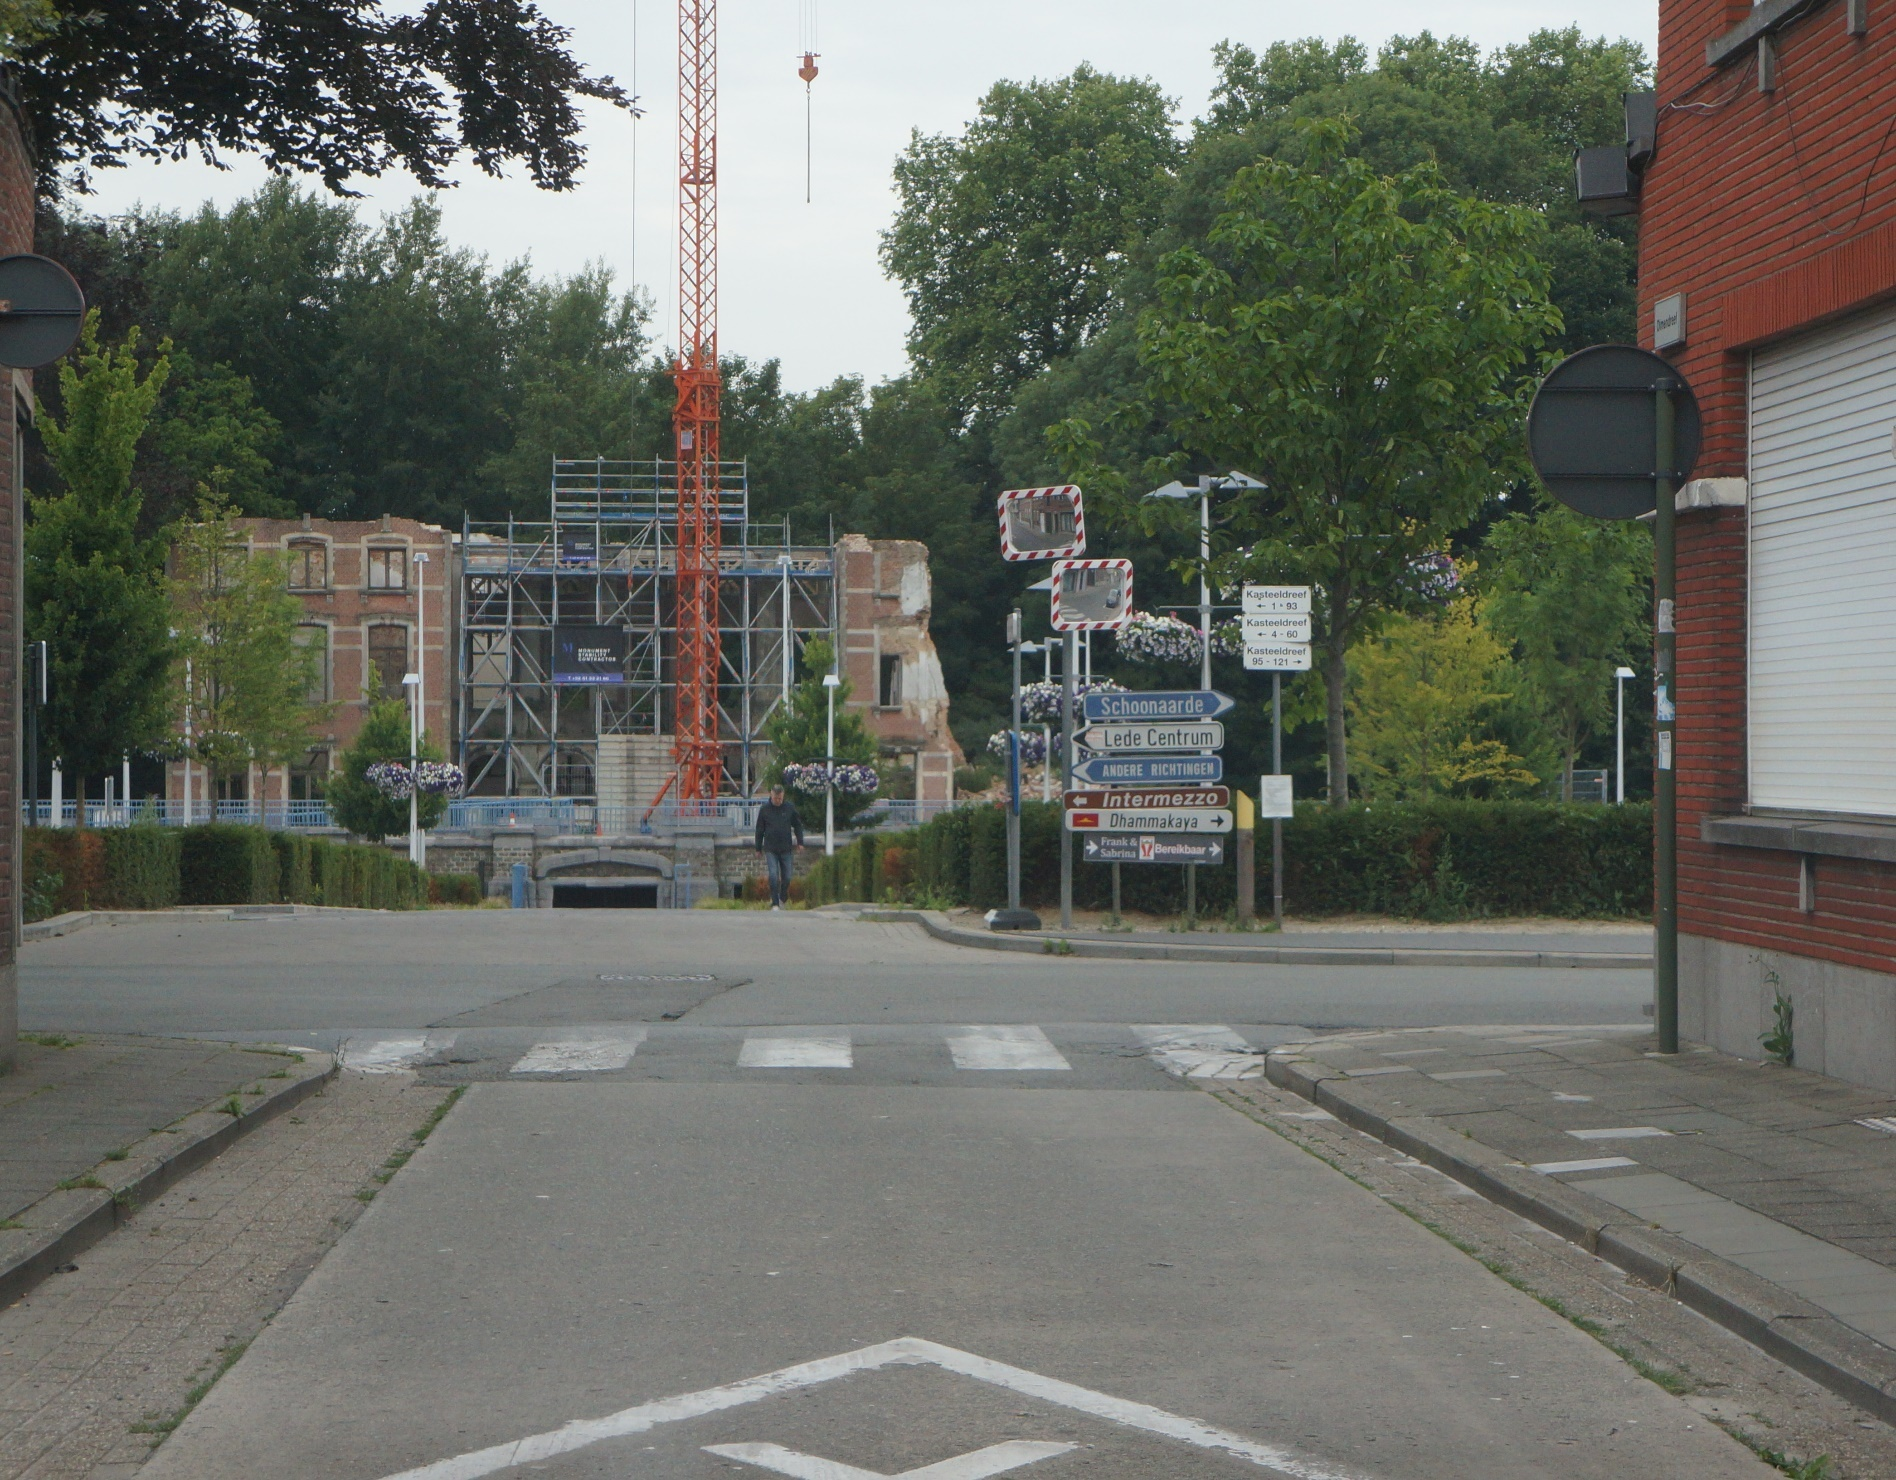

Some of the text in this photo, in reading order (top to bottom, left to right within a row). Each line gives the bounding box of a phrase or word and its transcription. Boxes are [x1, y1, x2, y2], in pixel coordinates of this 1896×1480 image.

[1246, 590, 1307, 598] Kasteeldreef
[1271, 602, 1276, 610] 1
[1286, 602, 1298, 610] 93
[1246, 619, 1308, 627] Kasteeldreef
[1271, 630, 1277, 638] 4
[1286, 630, 1298, 638] 60
[1246, 647, 1307, 655] Kasteeldreef
[1252, 657, 1263, 665] 95
[1273, 658, 1289, 666] 121
[1101, 695, 1204, 715] Schoonaarde
[1104, 728, 1213, 747] Lede Centrum
[1102, 762, 1214, 777] ANDERE RICHTINGEN
[1102, 791, 1218, 808] Intermezzo
[1110, 813, 1198, 831] Dhammakaya
[1100, 837, 1138, 846] Frank &
[1100, 849, 1136, 858] Sabrina
[1154, 844, 1206, 855] Bereikbaar
